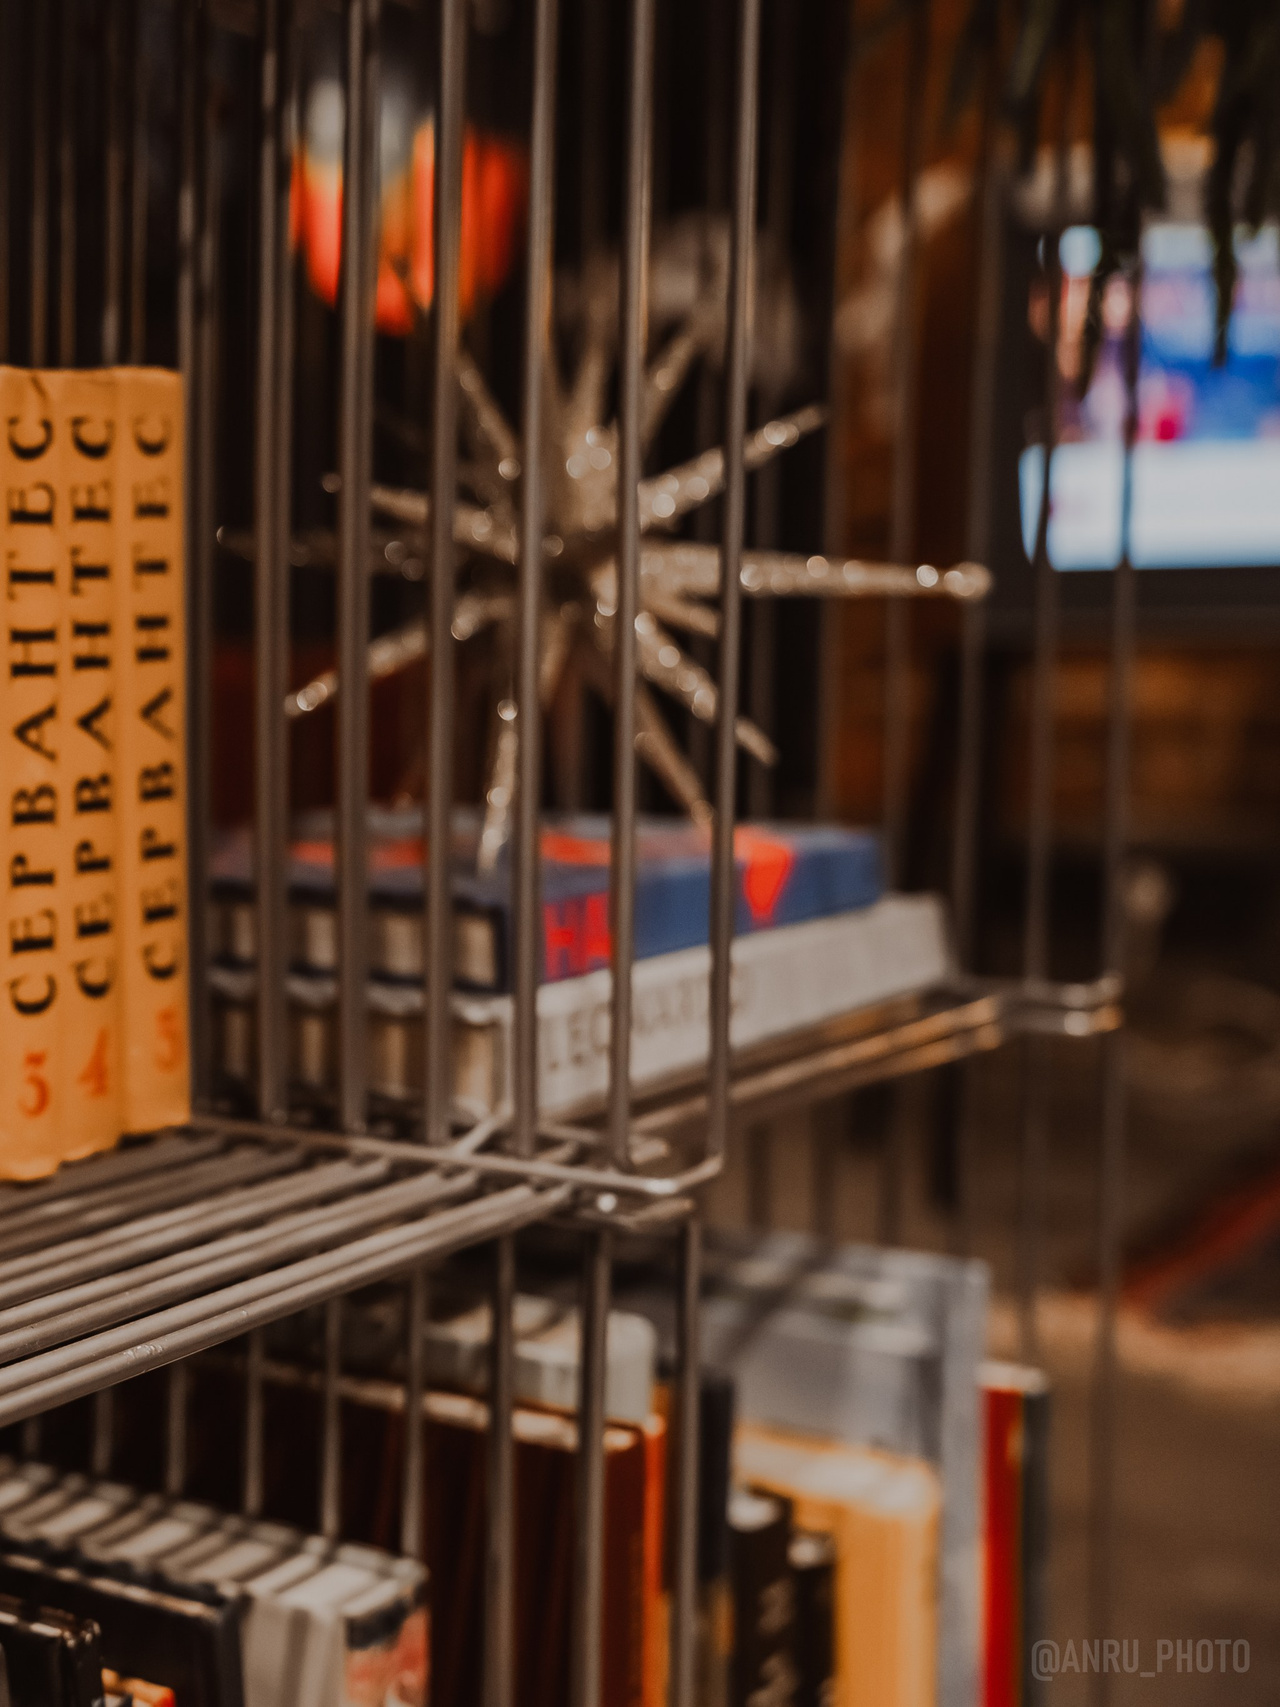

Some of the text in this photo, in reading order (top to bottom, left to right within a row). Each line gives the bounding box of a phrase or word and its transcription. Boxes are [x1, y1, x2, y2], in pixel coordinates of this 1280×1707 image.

[8, 414, 58, 1017] СЕРВАНТЕС
[70, 413, 116, 998] СЕРВАНТЕС
[131, 412, 180, 981] СЕРВАНТЕС
[20, 1050, 51, 1120] 3
[77, 1025, 110, 1098] 4
